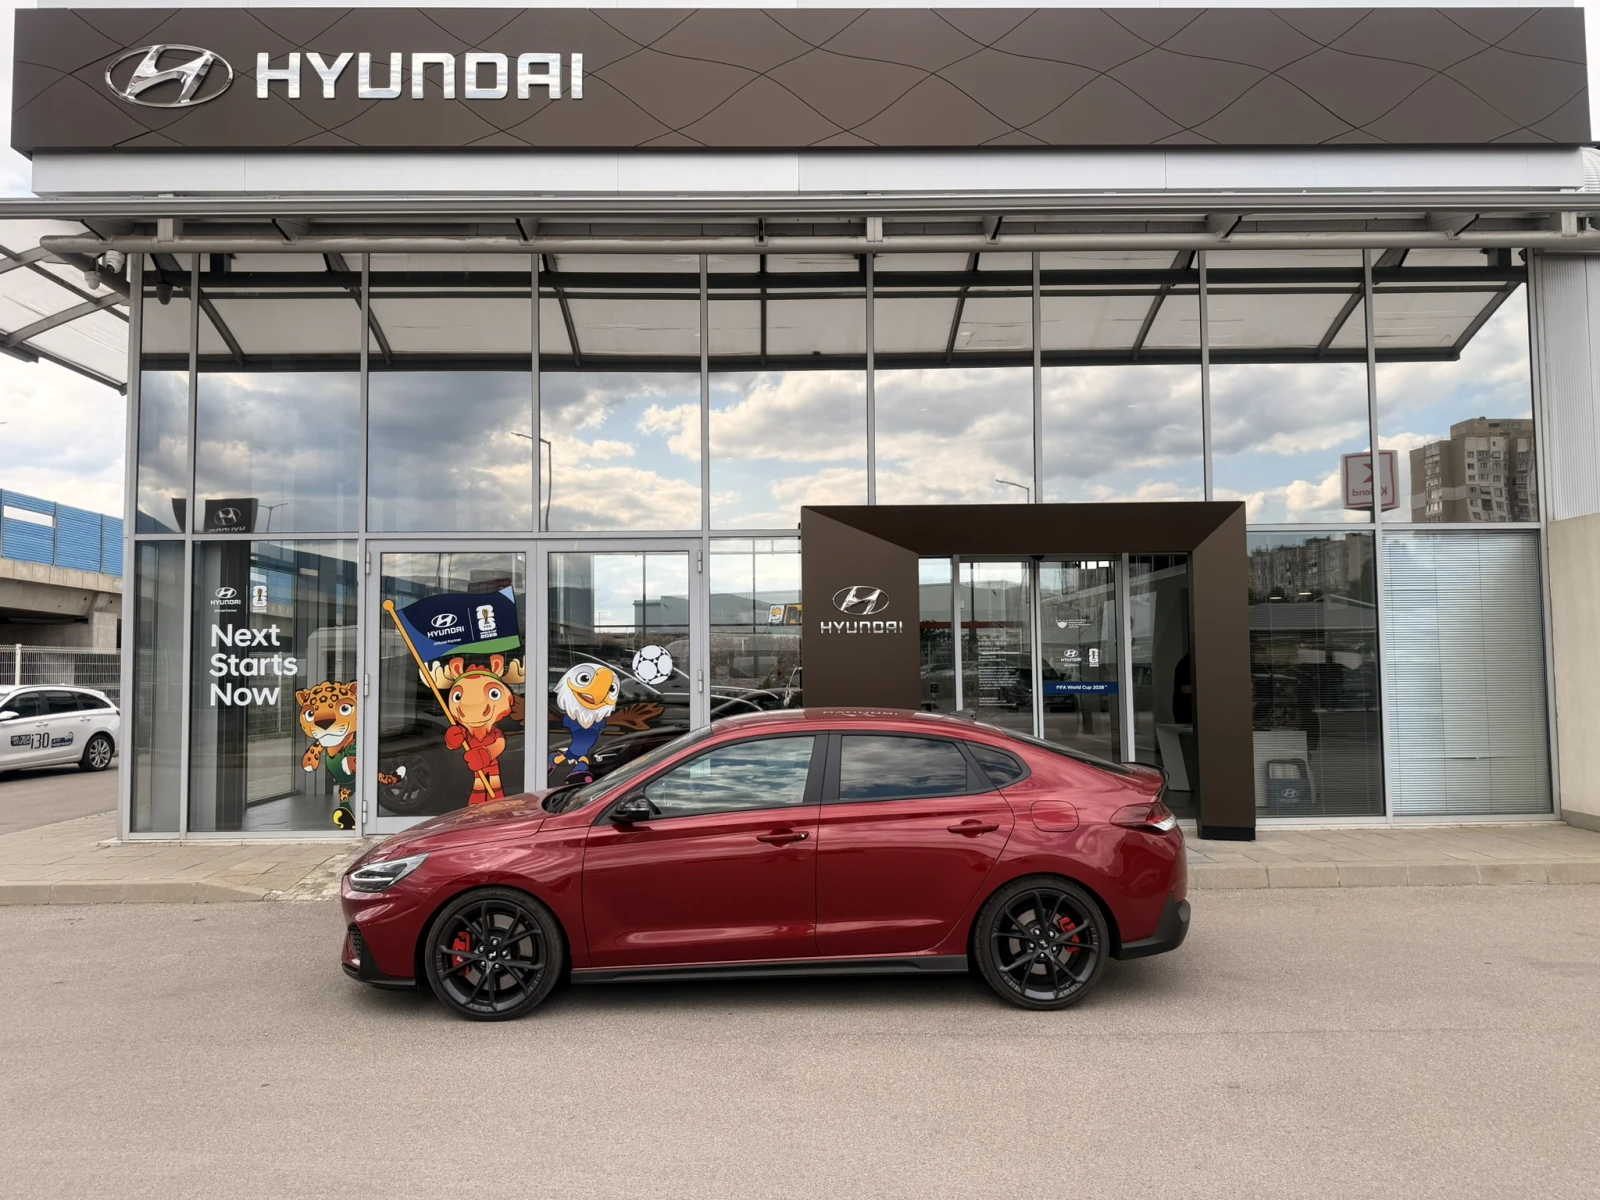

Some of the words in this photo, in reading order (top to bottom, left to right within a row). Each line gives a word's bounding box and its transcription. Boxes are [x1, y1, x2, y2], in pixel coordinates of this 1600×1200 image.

[256, 52, 583, 99] HYUNDAI
[211, 623, 281, 647] Next
[427, 626, 465, 638] HYUNDAI
[820, 621, 903, 634] HYUNDAI
[209, 653, 298, 677] Starts
[210, 683, 280, 706] Now
[31, 732, 50, 749] i30
